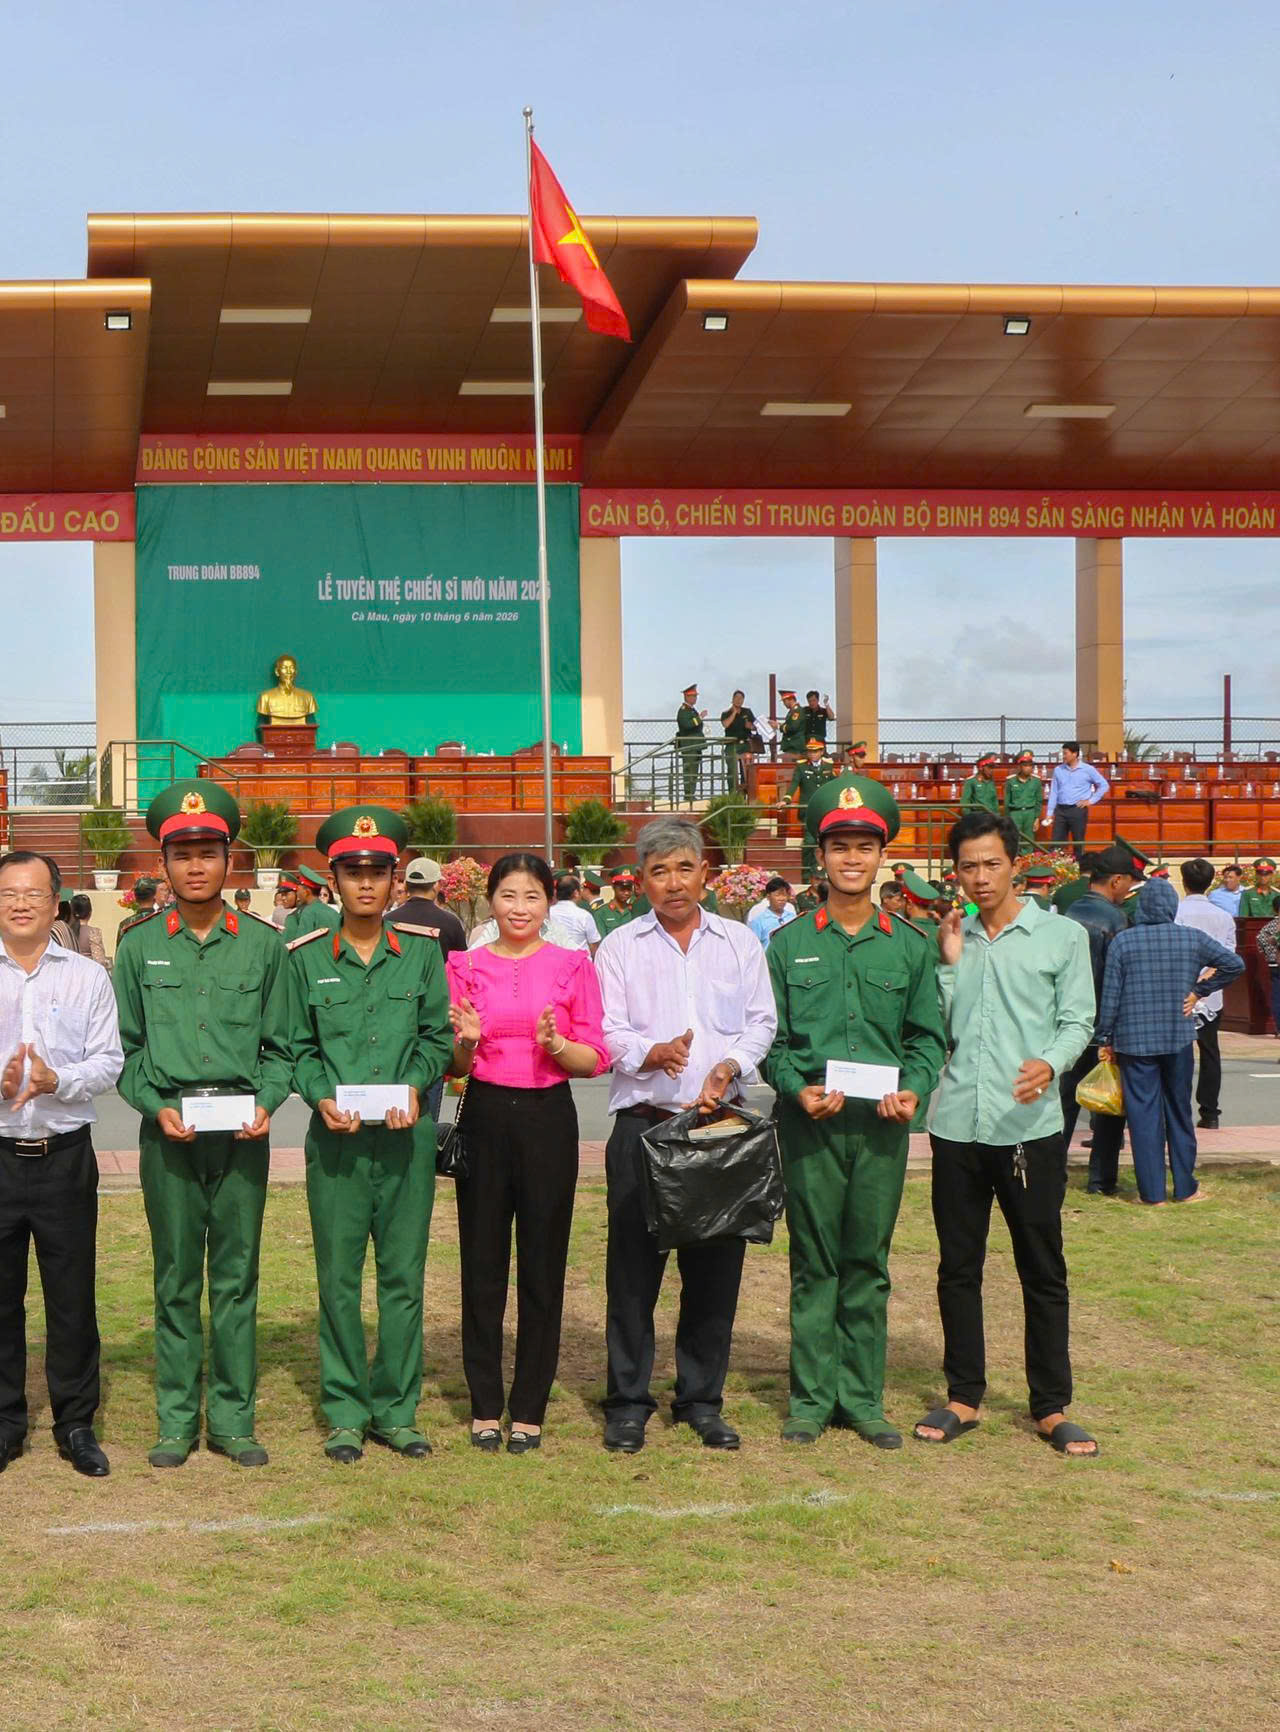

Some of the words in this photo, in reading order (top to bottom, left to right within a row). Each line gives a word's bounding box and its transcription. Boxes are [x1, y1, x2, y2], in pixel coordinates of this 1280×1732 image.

[143, 442, 188, 470] ĐẢNG
[193, 443, 240, 473] CỘNG
[245, 441, 280, 470] SẢN
[284, 444, 318, 473] VIỆT
[323, 448, 362, 469] NAM
[366, 448, 423, 471] QUANG
[427, 448, 466, 470] VINH
[470, 444, 520, 470] MUÔN
[0, 502, 55, 534] ĐẤU
[64, 509, 120, 533] CAO
[588, 500, 630, 526] CÁN
[636, 499, 669, 530] BỘ,
[676, 496, 736, 526] CHIẾN
[744, 500, 762, 526] SĨ
[767, 504, 835, 526] TRUNG
[842, 501, 896, 527] ĐOÀN
[904, 500, 931, 530] BỘ
[936, 506, 984, 527] BINH
[988, 506, 1020, 528] 894
[1026, 498, 1064, 528] SẴN
[1072, 503, 1124, 528] SÀNG
[1131, 502, 1184, 532] NHẬN
[1191, 503, 1216, 528] VÀ
[1222, 503, 1275, 528] HOÀN
[168, 565, 199, 580] TRUNG
[230, 565, 260, 579] BB894
[318, 572, 333, 600] LỄ
[336, 576, 375, 600] TUYÊN
[378, 576, 400, 604] THỆ
[405, 574, 442, 600] CHIẾN
[445, 577, 458, 600] SĨ
[461, 576, 485, 600] MỚI
[489, 577, 517, 600] NĂM
[352, 612, 364, 621] Cà
[367, 612, 389, 621] Mau,
[393, 613, 416, 623] ngày
[421, 612, 432, 621] 10
[434, 612, 461, 623] tháng
[464, 612, 470, 621] 6
[472, 612, 493, 621] năm
[496, 612, 518, 621] 2026
